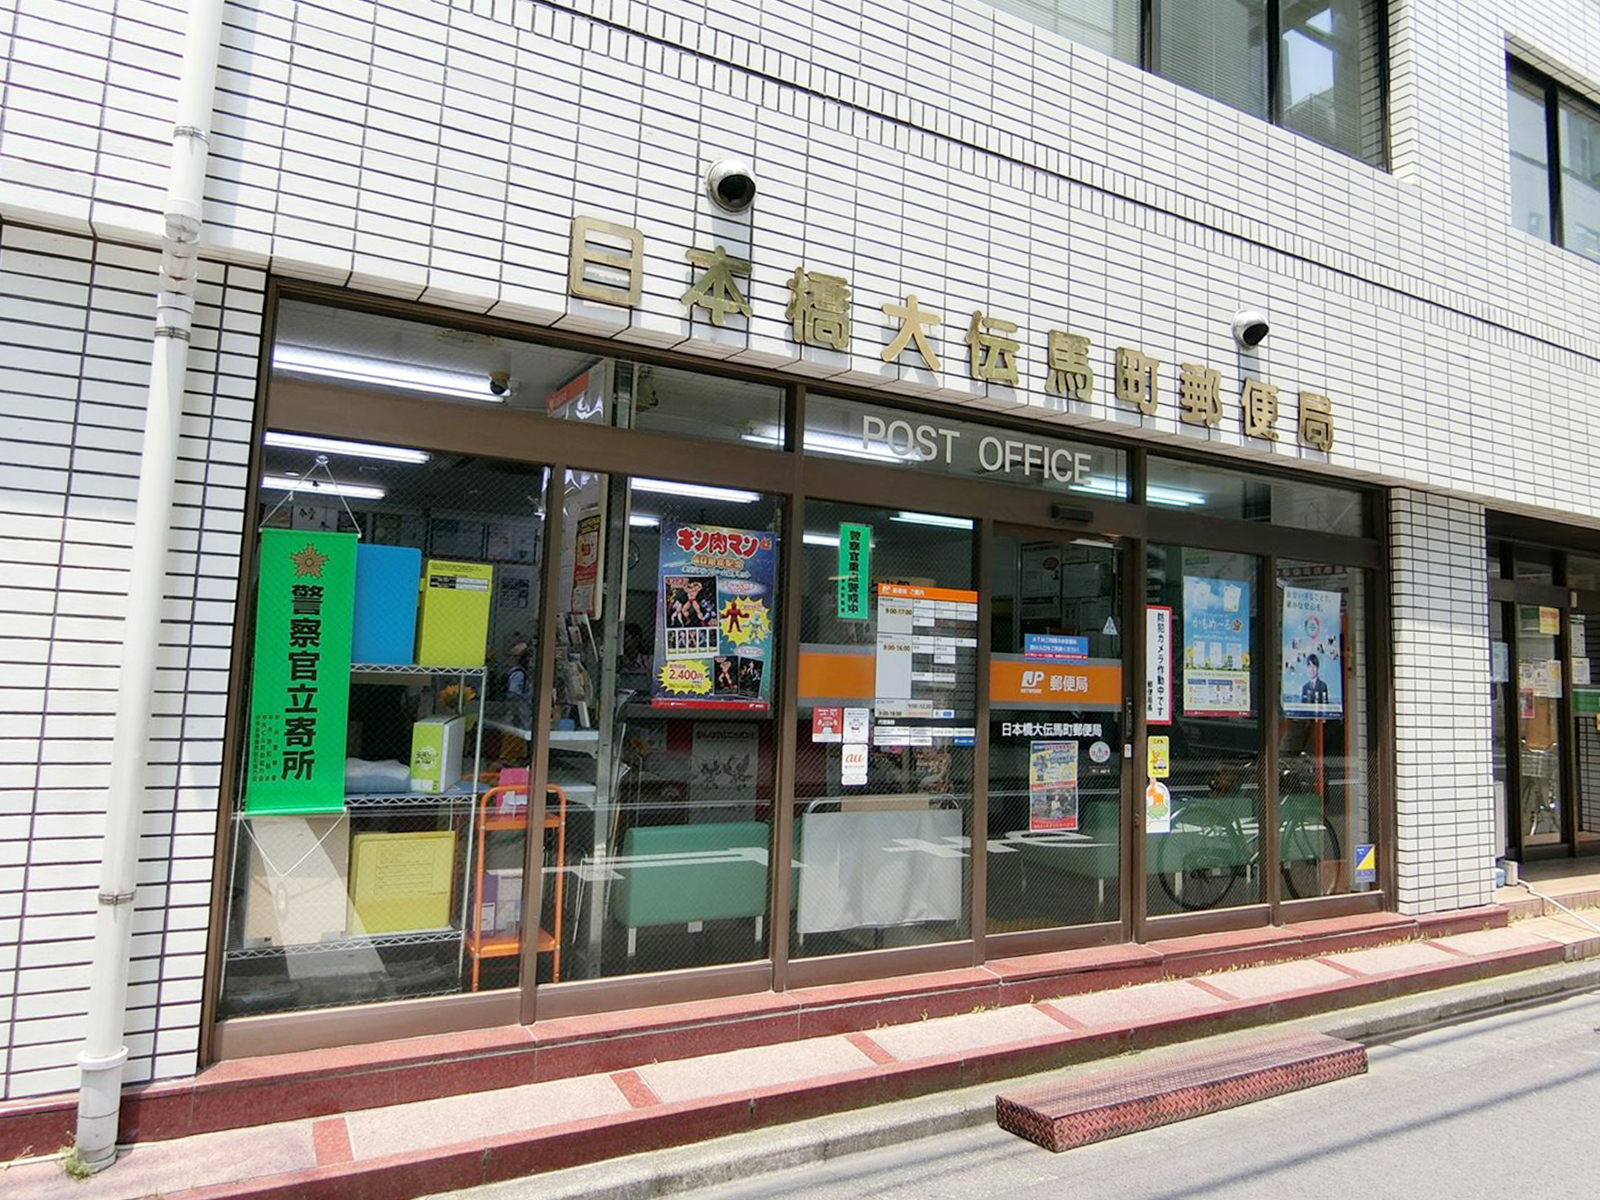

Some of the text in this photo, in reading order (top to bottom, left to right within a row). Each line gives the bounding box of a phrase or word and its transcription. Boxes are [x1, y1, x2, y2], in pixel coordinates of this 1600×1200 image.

[570, 214, 1334, 453] 日本橋大伝馬町郵便局
[861, 414, 1093, 487] POST OFFICE
[676, 526, 760, 559] キン肉マン
[281, 584, 324, 781] 警察官立寄所
[1049, 674, 1088, 693] 郵便局
[1156, 612, 1166, 717] 防犯カメラ作動中です
[1001, 722, 1103, 738] 日本橋大伝馬町郵便局
[845, 753, 863, 764] au
